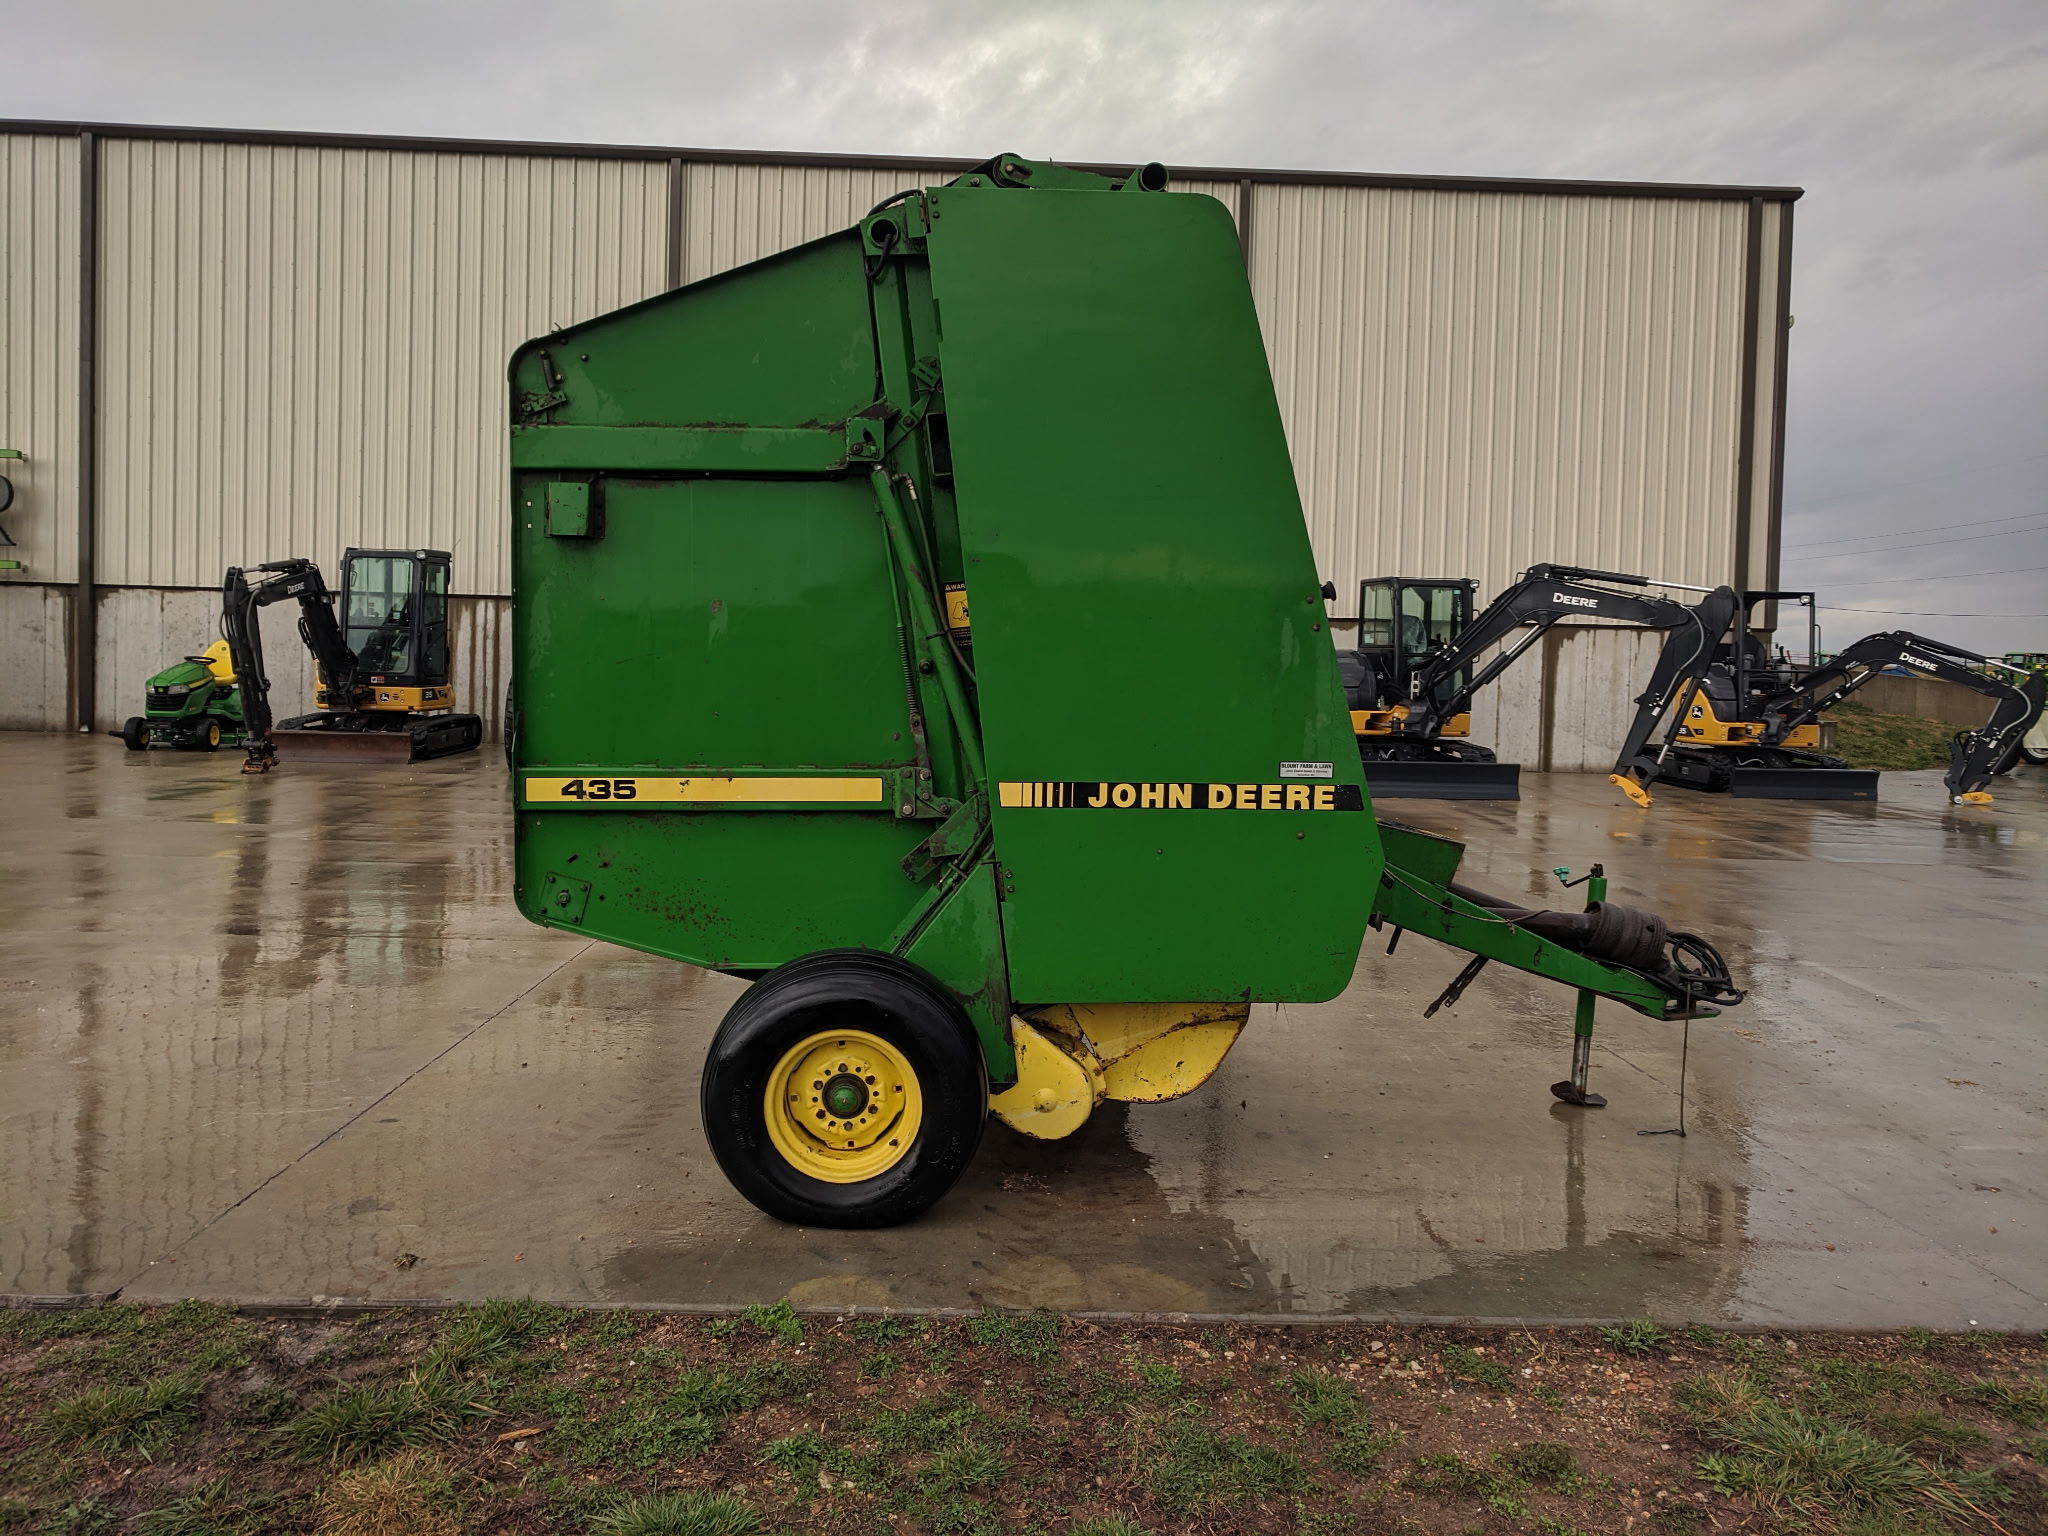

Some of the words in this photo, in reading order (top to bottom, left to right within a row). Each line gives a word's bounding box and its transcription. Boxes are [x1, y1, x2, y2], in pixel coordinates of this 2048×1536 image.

[287, 581, 305, 595] DEERE
[1552, 592, 1599, 608] DEERE
[1899, 651, 1939, 671] DEERE
[561, 780, 637, 800] 435
[1087, 782, 1192, 809] JOHN
[1208, 783, 1336, 811] DEERE
